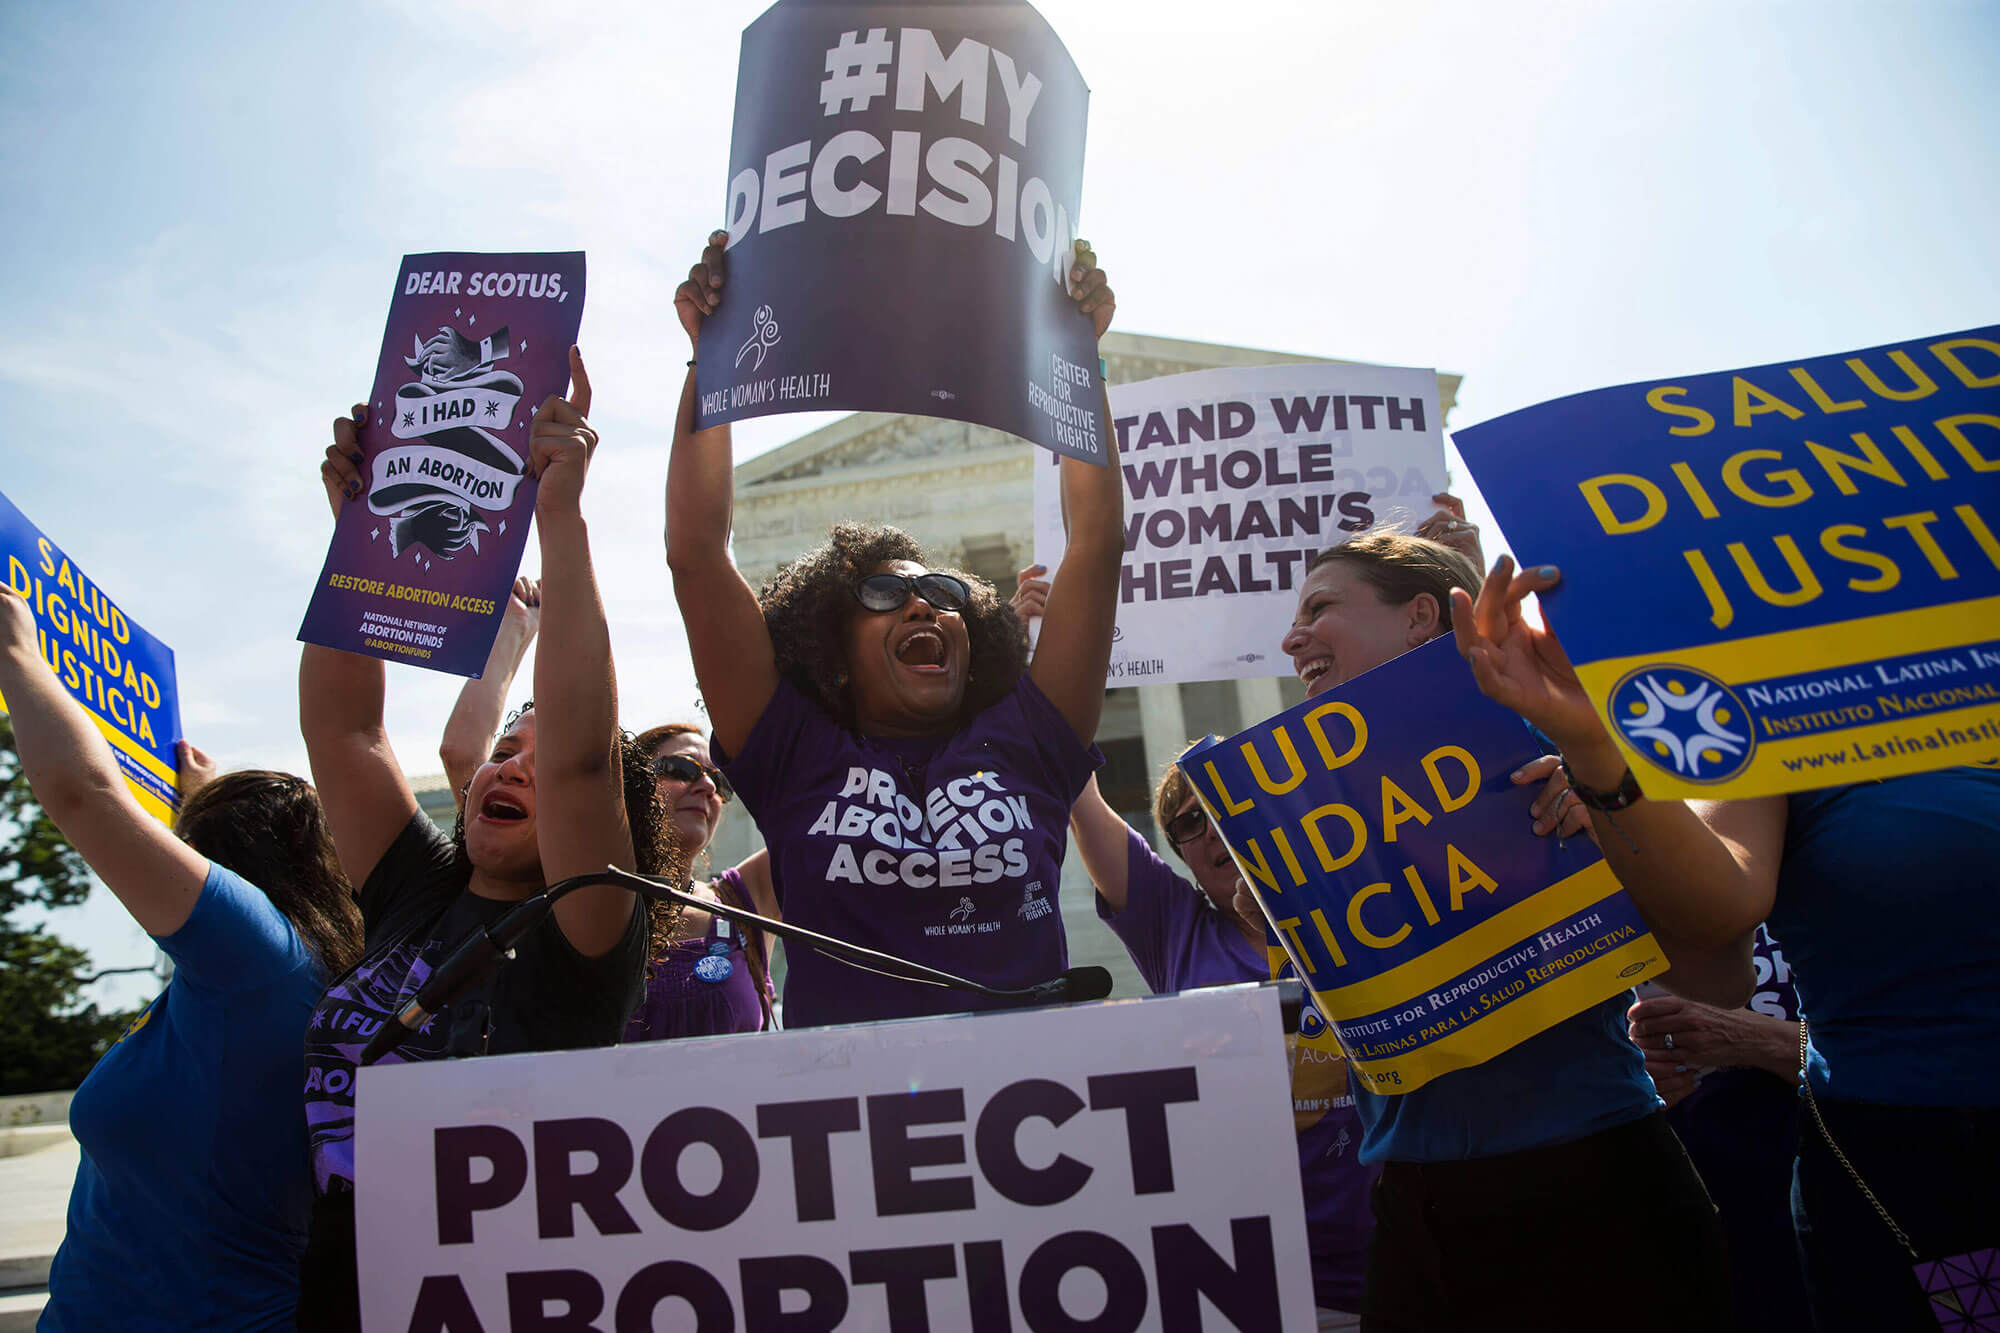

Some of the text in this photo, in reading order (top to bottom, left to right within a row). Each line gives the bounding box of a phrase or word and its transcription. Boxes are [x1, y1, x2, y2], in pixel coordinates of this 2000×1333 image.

[819, 27, 1042, 146] #MY
[405, 271, 569, 303] DEAR SCOTUS,
[702, 373, 830, 416] WHOLE WOMAN'S HEALTH
[1053, 353, 1090, 388] CENTER
[1053, 376, 1072, 403] FOR
[1645, 338, 2000, 437] SALUD
[422, 399, 475, 424] I HAD
[1028, 380, 1096, 432] REPRODUCTIVE
[1113, 395, 1426, 453] TAND WITH
[1056, 421, 1098, 454] RIGHTS
[386, 457, 504, 499] AN ABORTION
[1123, 444, 1334, 500] WHOLE
[1578, 414, 2000, 535] DIGNID
[37, 537, 130, 645] SALUD
[329, 573, 495, 615] RESTORE ABORTION ACCESS
[9, 555, 160, 710] DIGNIDAD
[359, 622, 444, 649] ABORTION FUNDS
[363, 612, 447, 635] NATIONAL NETWORK OF
[39, 628, 157, 749] USTICIA
[1128, 659, 1164, 676] HEALTH
[1746, 673, 1873, 708] NATIONAL
[1874, 657, 1967, 685] LATINA
[1760, 683, 2000, 736] INSTITUTO NACIONAL
[1186, 701, 1369, 821] LUD
[825, 838, 1029, 889] ACCESS
[924, 925, 946, 936] WHOLE
[977, 921, 1001, 933] HEALTH
[1362, 1033, 1417, 1056] LATINAS
[1420, 1016, 1458, 1041] PARA
[1460, 1006, 1479, 1022] LA
[1479, 979, 1525, 1011] SALUD
[1526, 924, 1636, 985] REPRODUCTIVA
[1394, 1006, 1427, 1026] FOR
[1428, 945, 1537, 1010] REPRODUCTIVE
[1539, 912, 1603, 952] HEALTH
[434, 1065, 1199, 1246] PROTECT
[408, 1215, 1284, 1333] ABORTION
